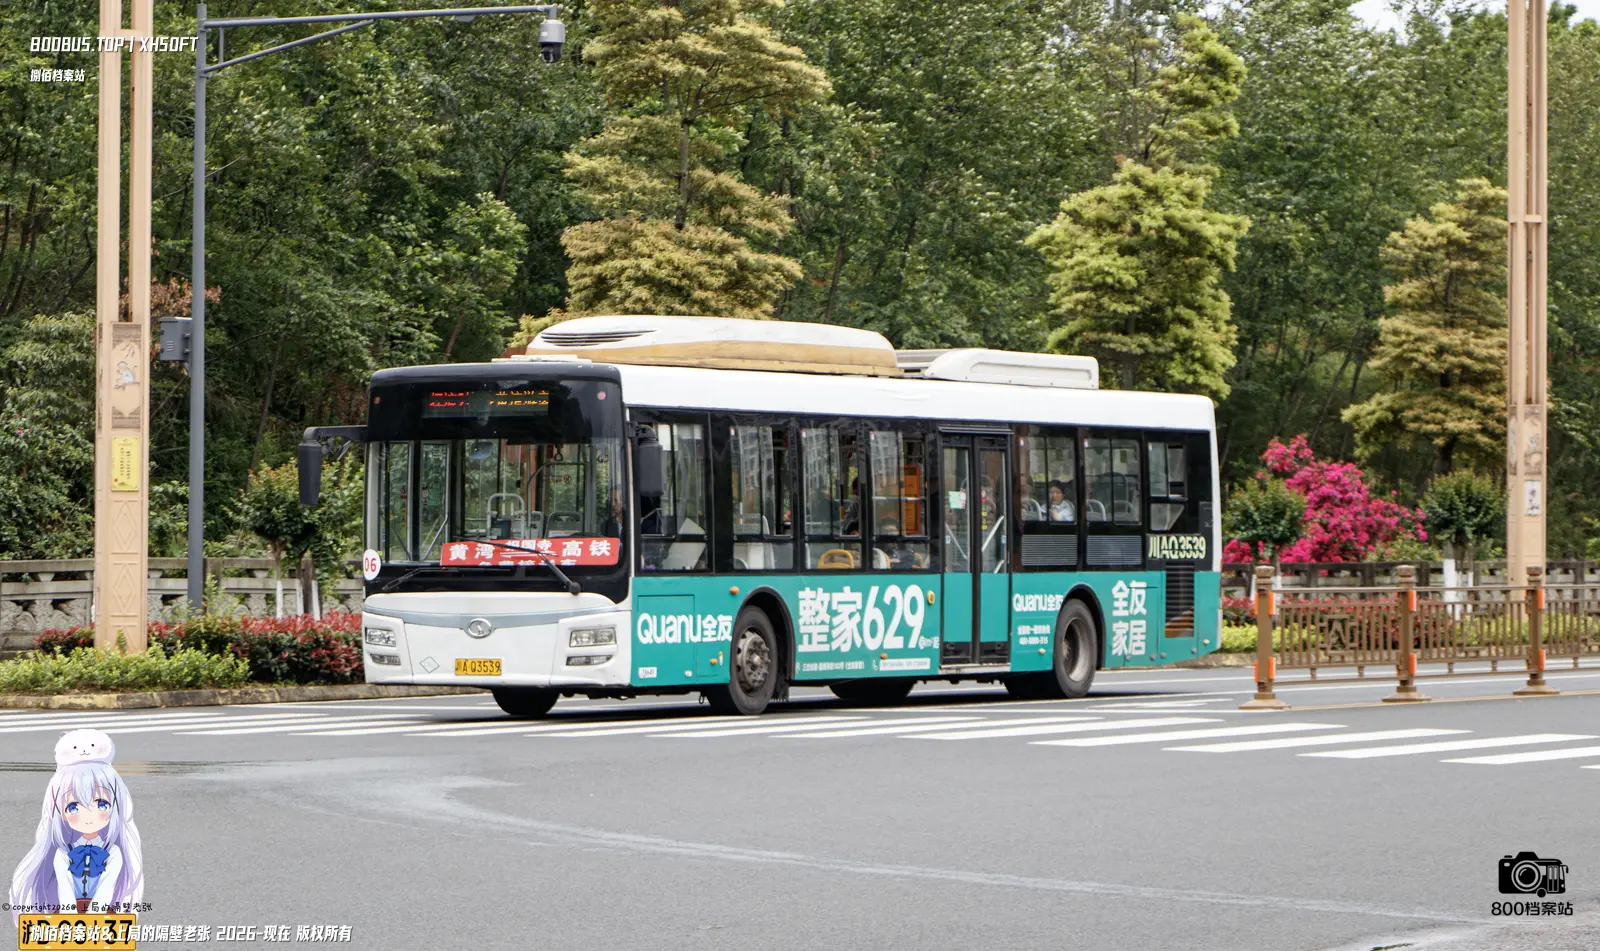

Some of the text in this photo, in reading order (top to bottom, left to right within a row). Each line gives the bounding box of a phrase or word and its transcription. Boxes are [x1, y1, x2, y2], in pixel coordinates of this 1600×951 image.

[449, 543, 495, 560] 黄湾
[562, 539, 611, 557] 高铁
[1148, 535, 1206, 560] 川AQ3539
[364, 557, 377, 573] 06
[1112, 580, 1147, 616] 全友
[1112, 620, 1147, 657] 家居
